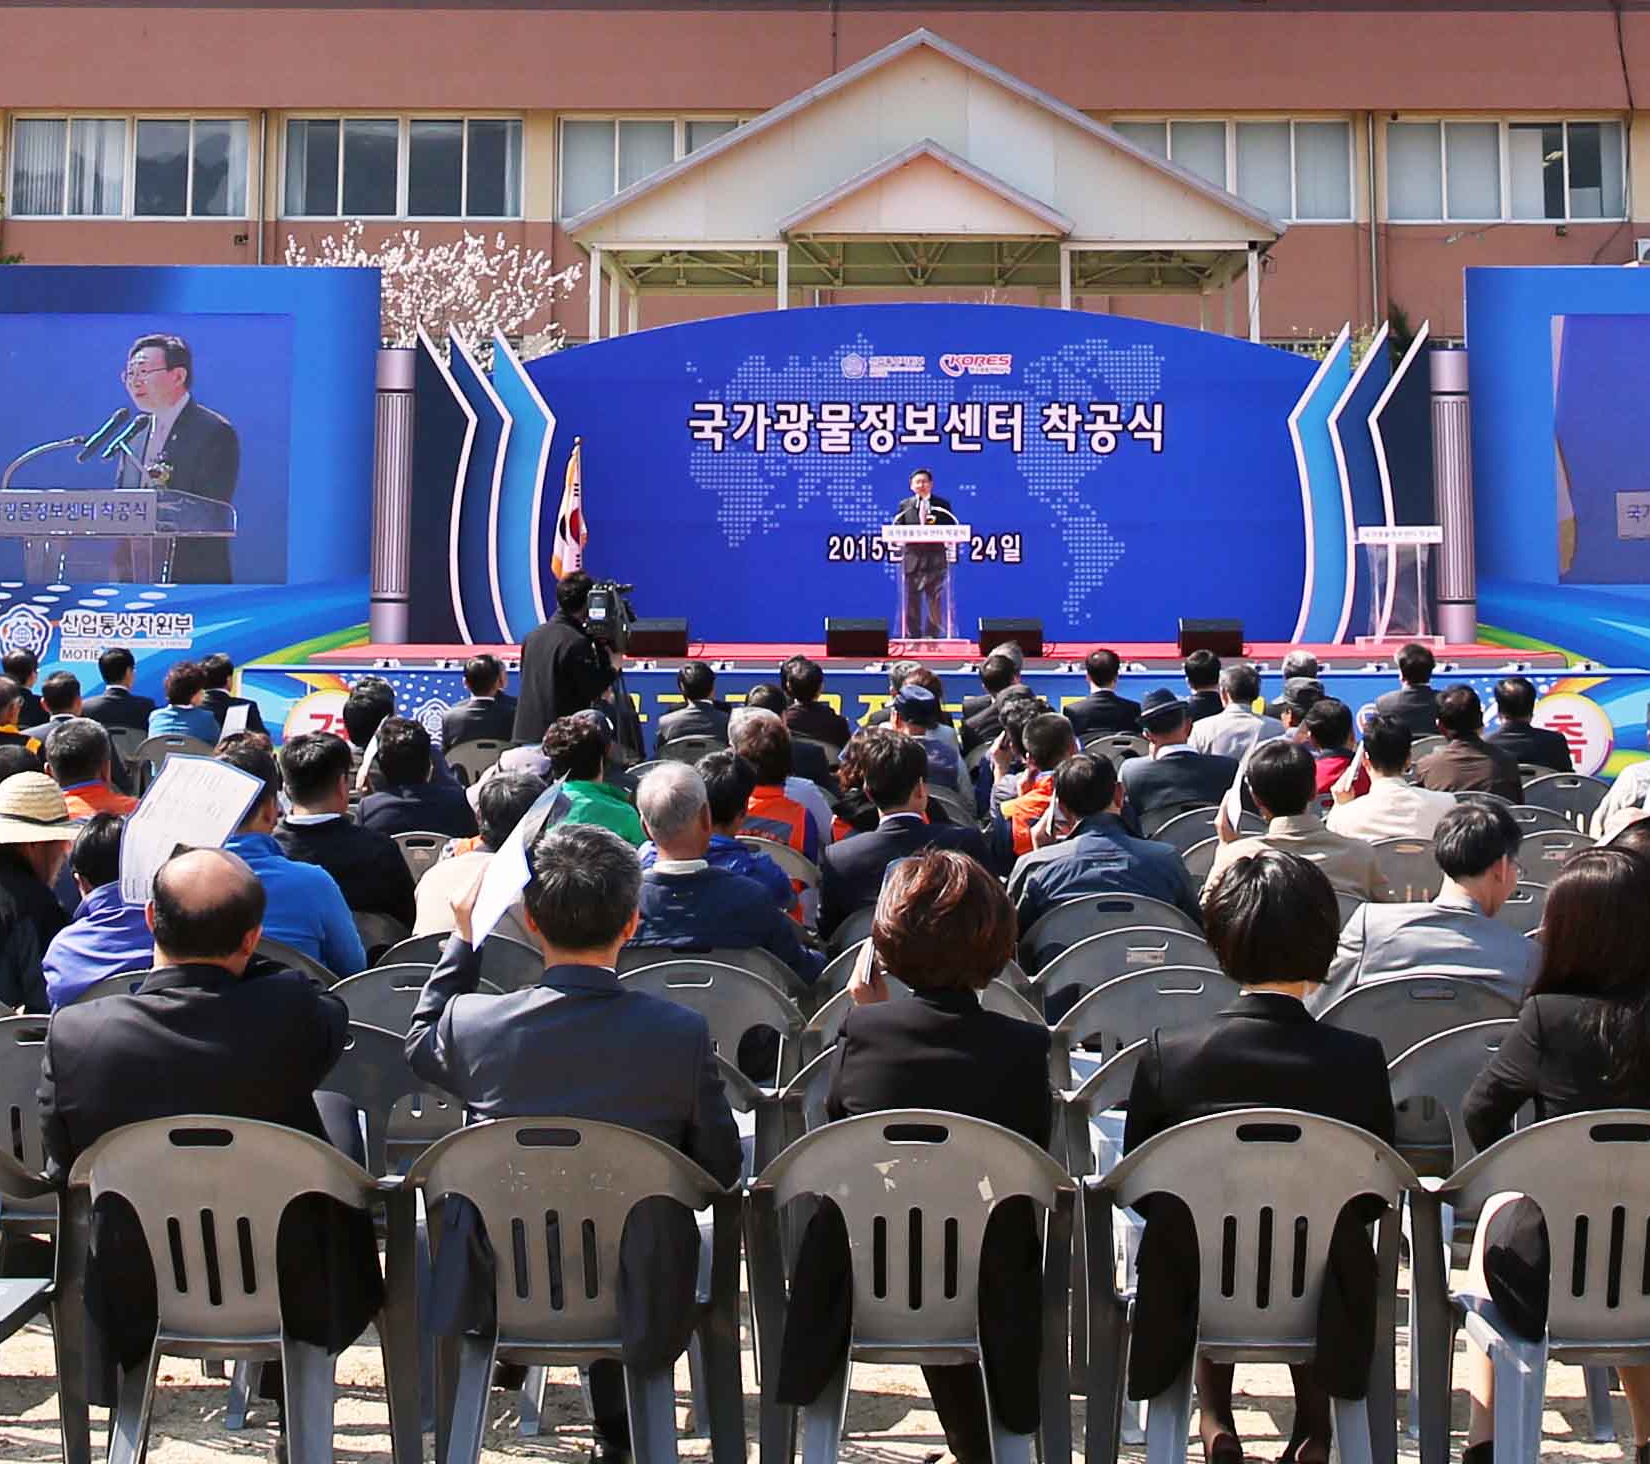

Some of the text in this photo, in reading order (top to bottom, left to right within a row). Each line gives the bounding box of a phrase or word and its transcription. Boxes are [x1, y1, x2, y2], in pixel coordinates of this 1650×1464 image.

[947, 355, 1010, 369] KORES
[688, 402, 1166, 454] 국가광물정보센터 착공식
[970, 534, 1022, 563] 24일
[61, 614, 192, 637] 산업통상자원부
[61, 648, 101, 660] MOTIE
